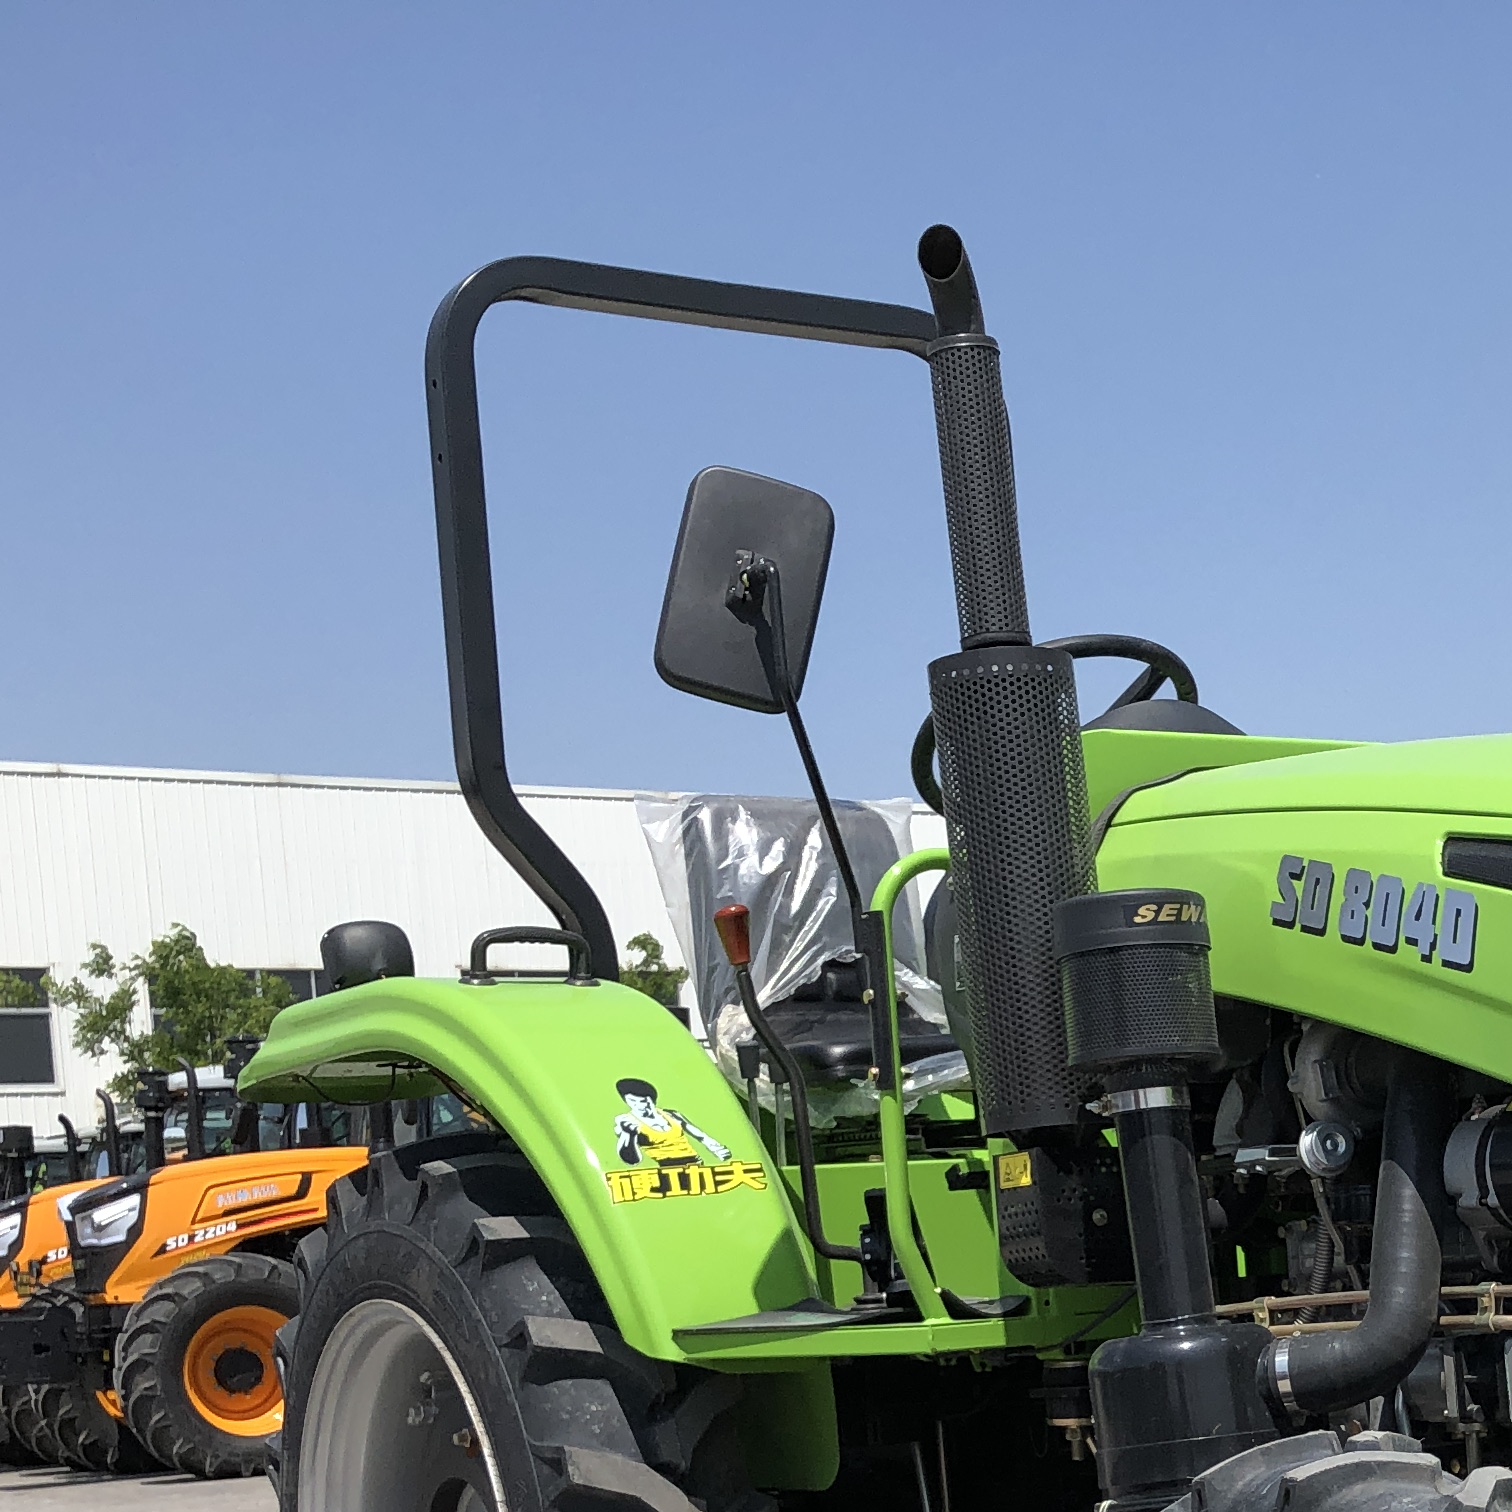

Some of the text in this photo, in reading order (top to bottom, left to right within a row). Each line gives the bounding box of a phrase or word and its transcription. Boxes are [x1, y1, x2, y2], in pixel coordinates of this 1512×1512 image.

[1270, 854, 1334, 937] SD
[606, 1160, 767, 1204] 硬功夫
[194, 1220, 237, 1243] 2204
